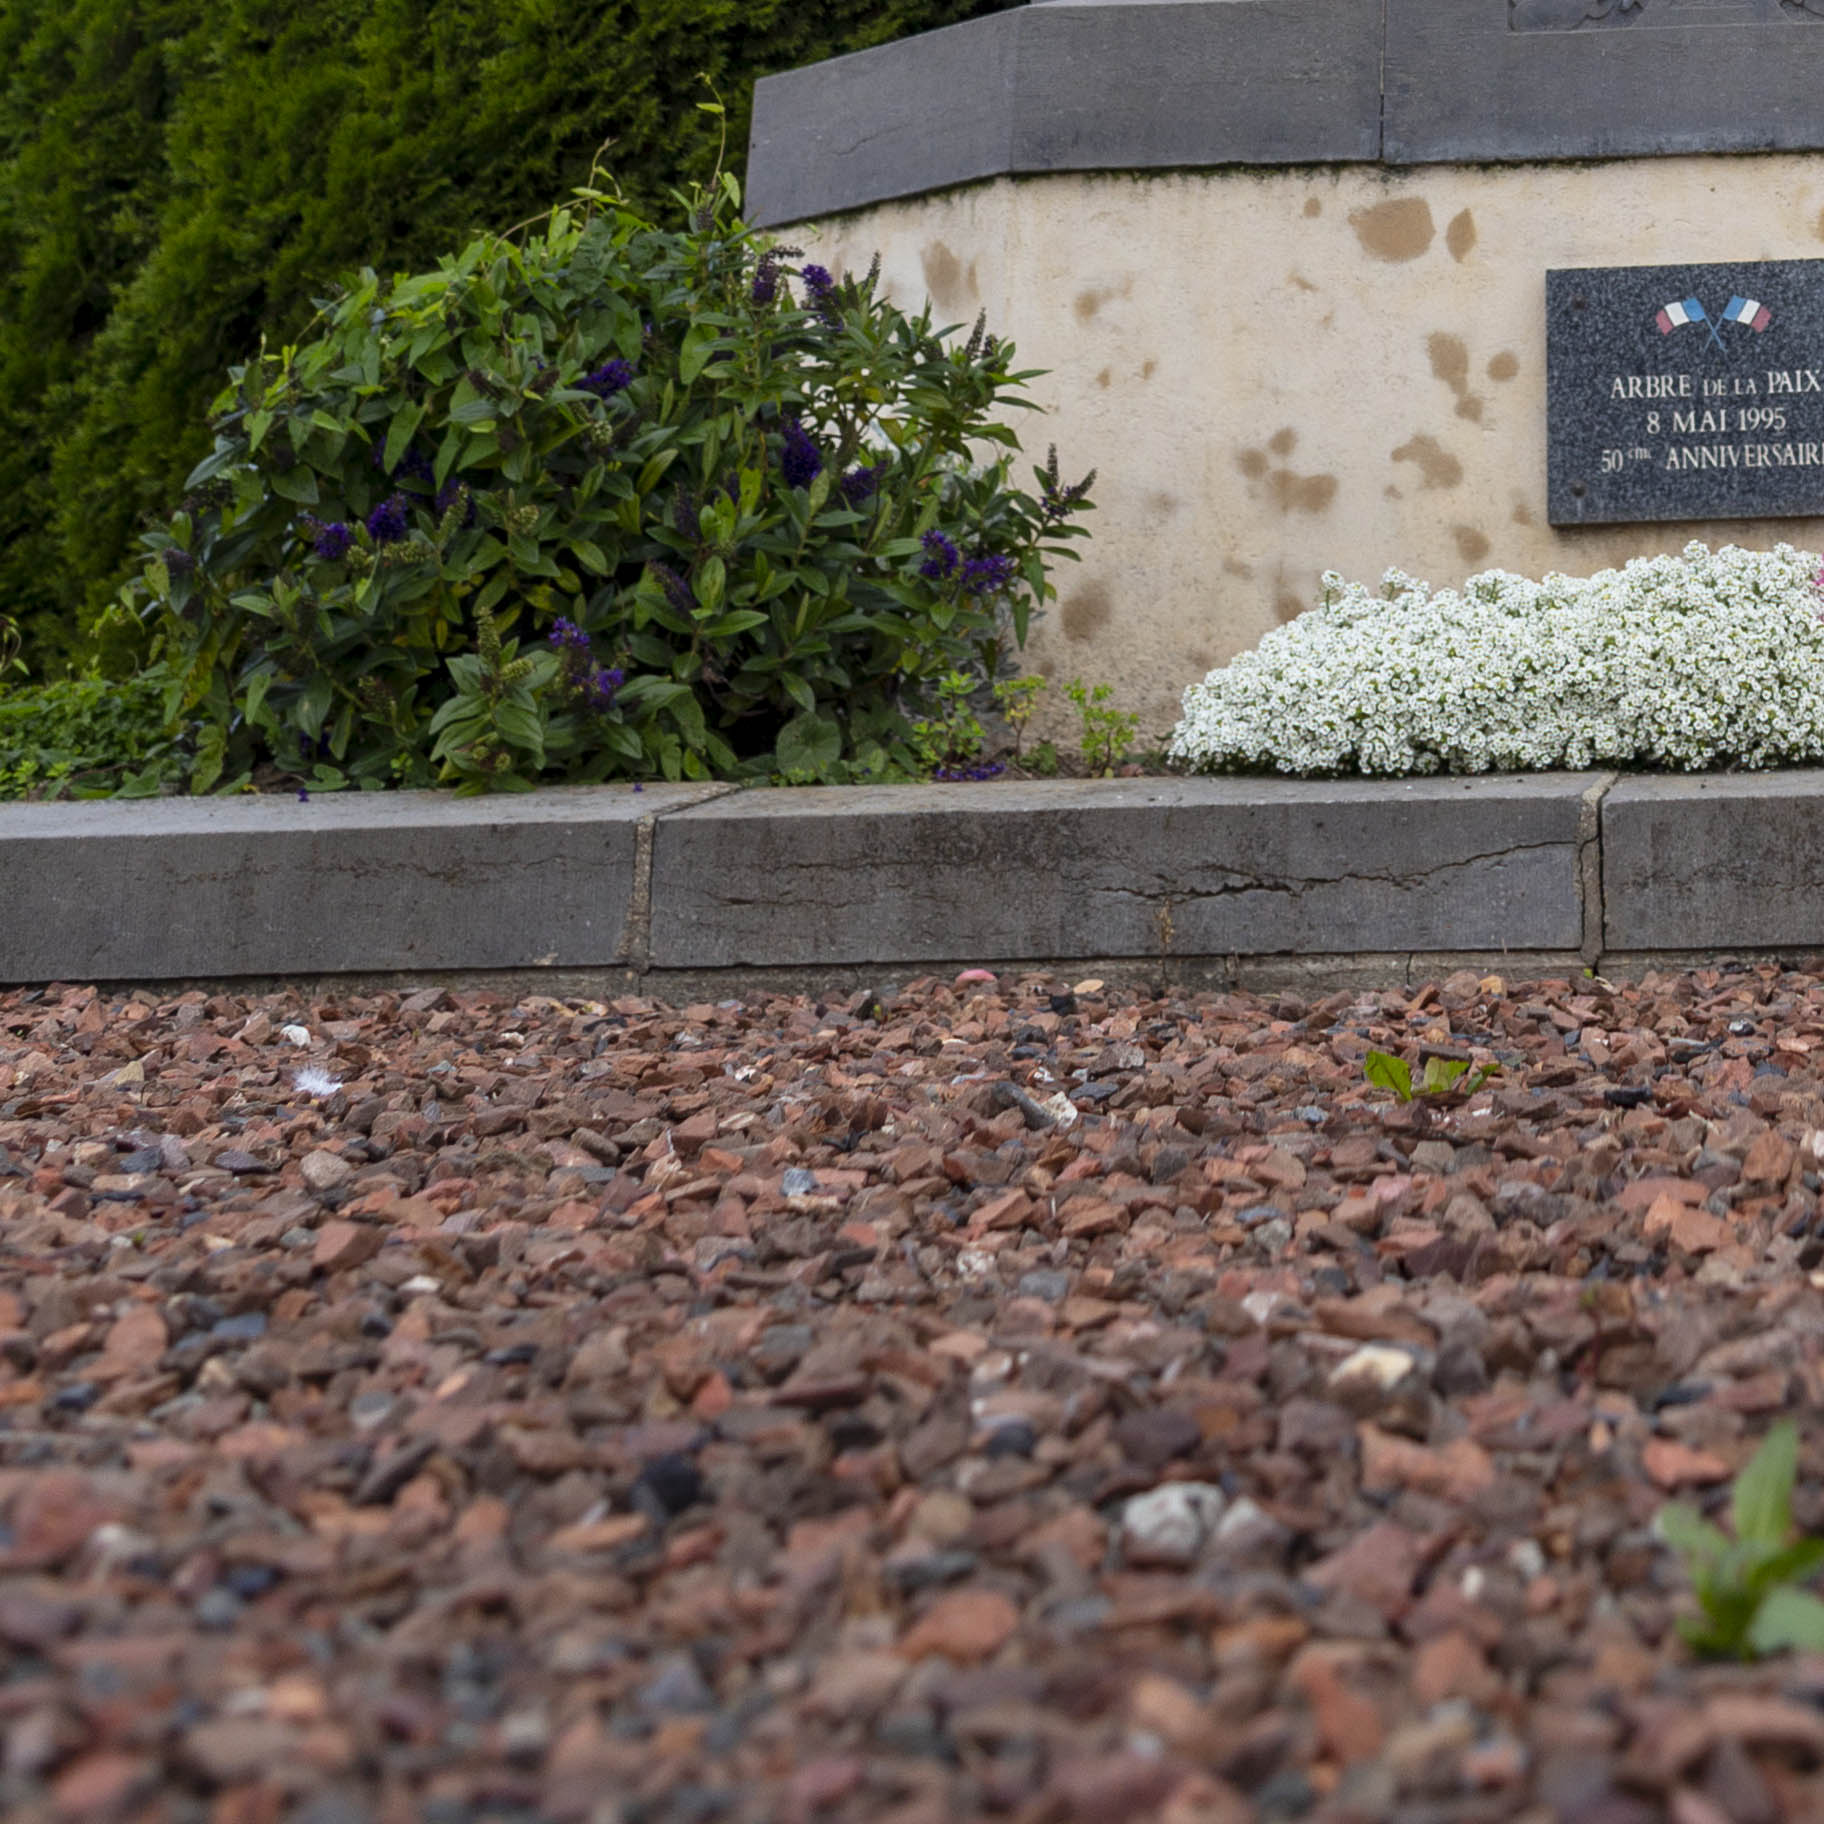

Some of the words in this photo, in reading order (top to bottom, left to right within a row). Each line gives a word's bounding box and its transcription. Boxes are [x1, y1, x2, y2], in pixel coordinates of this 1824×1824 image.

[1610, 374, 1693, 399] ARBRE
[1703, 378, 1727, 397] DE
[1734, 377, 1758, 396] LA
[1767, 369, 1822, 394] PAIX
[1646, 410, 1661, 434] 8
[1672, 409, 1727, 433] MAI
[1738, 407, 1787, 432] 1995
